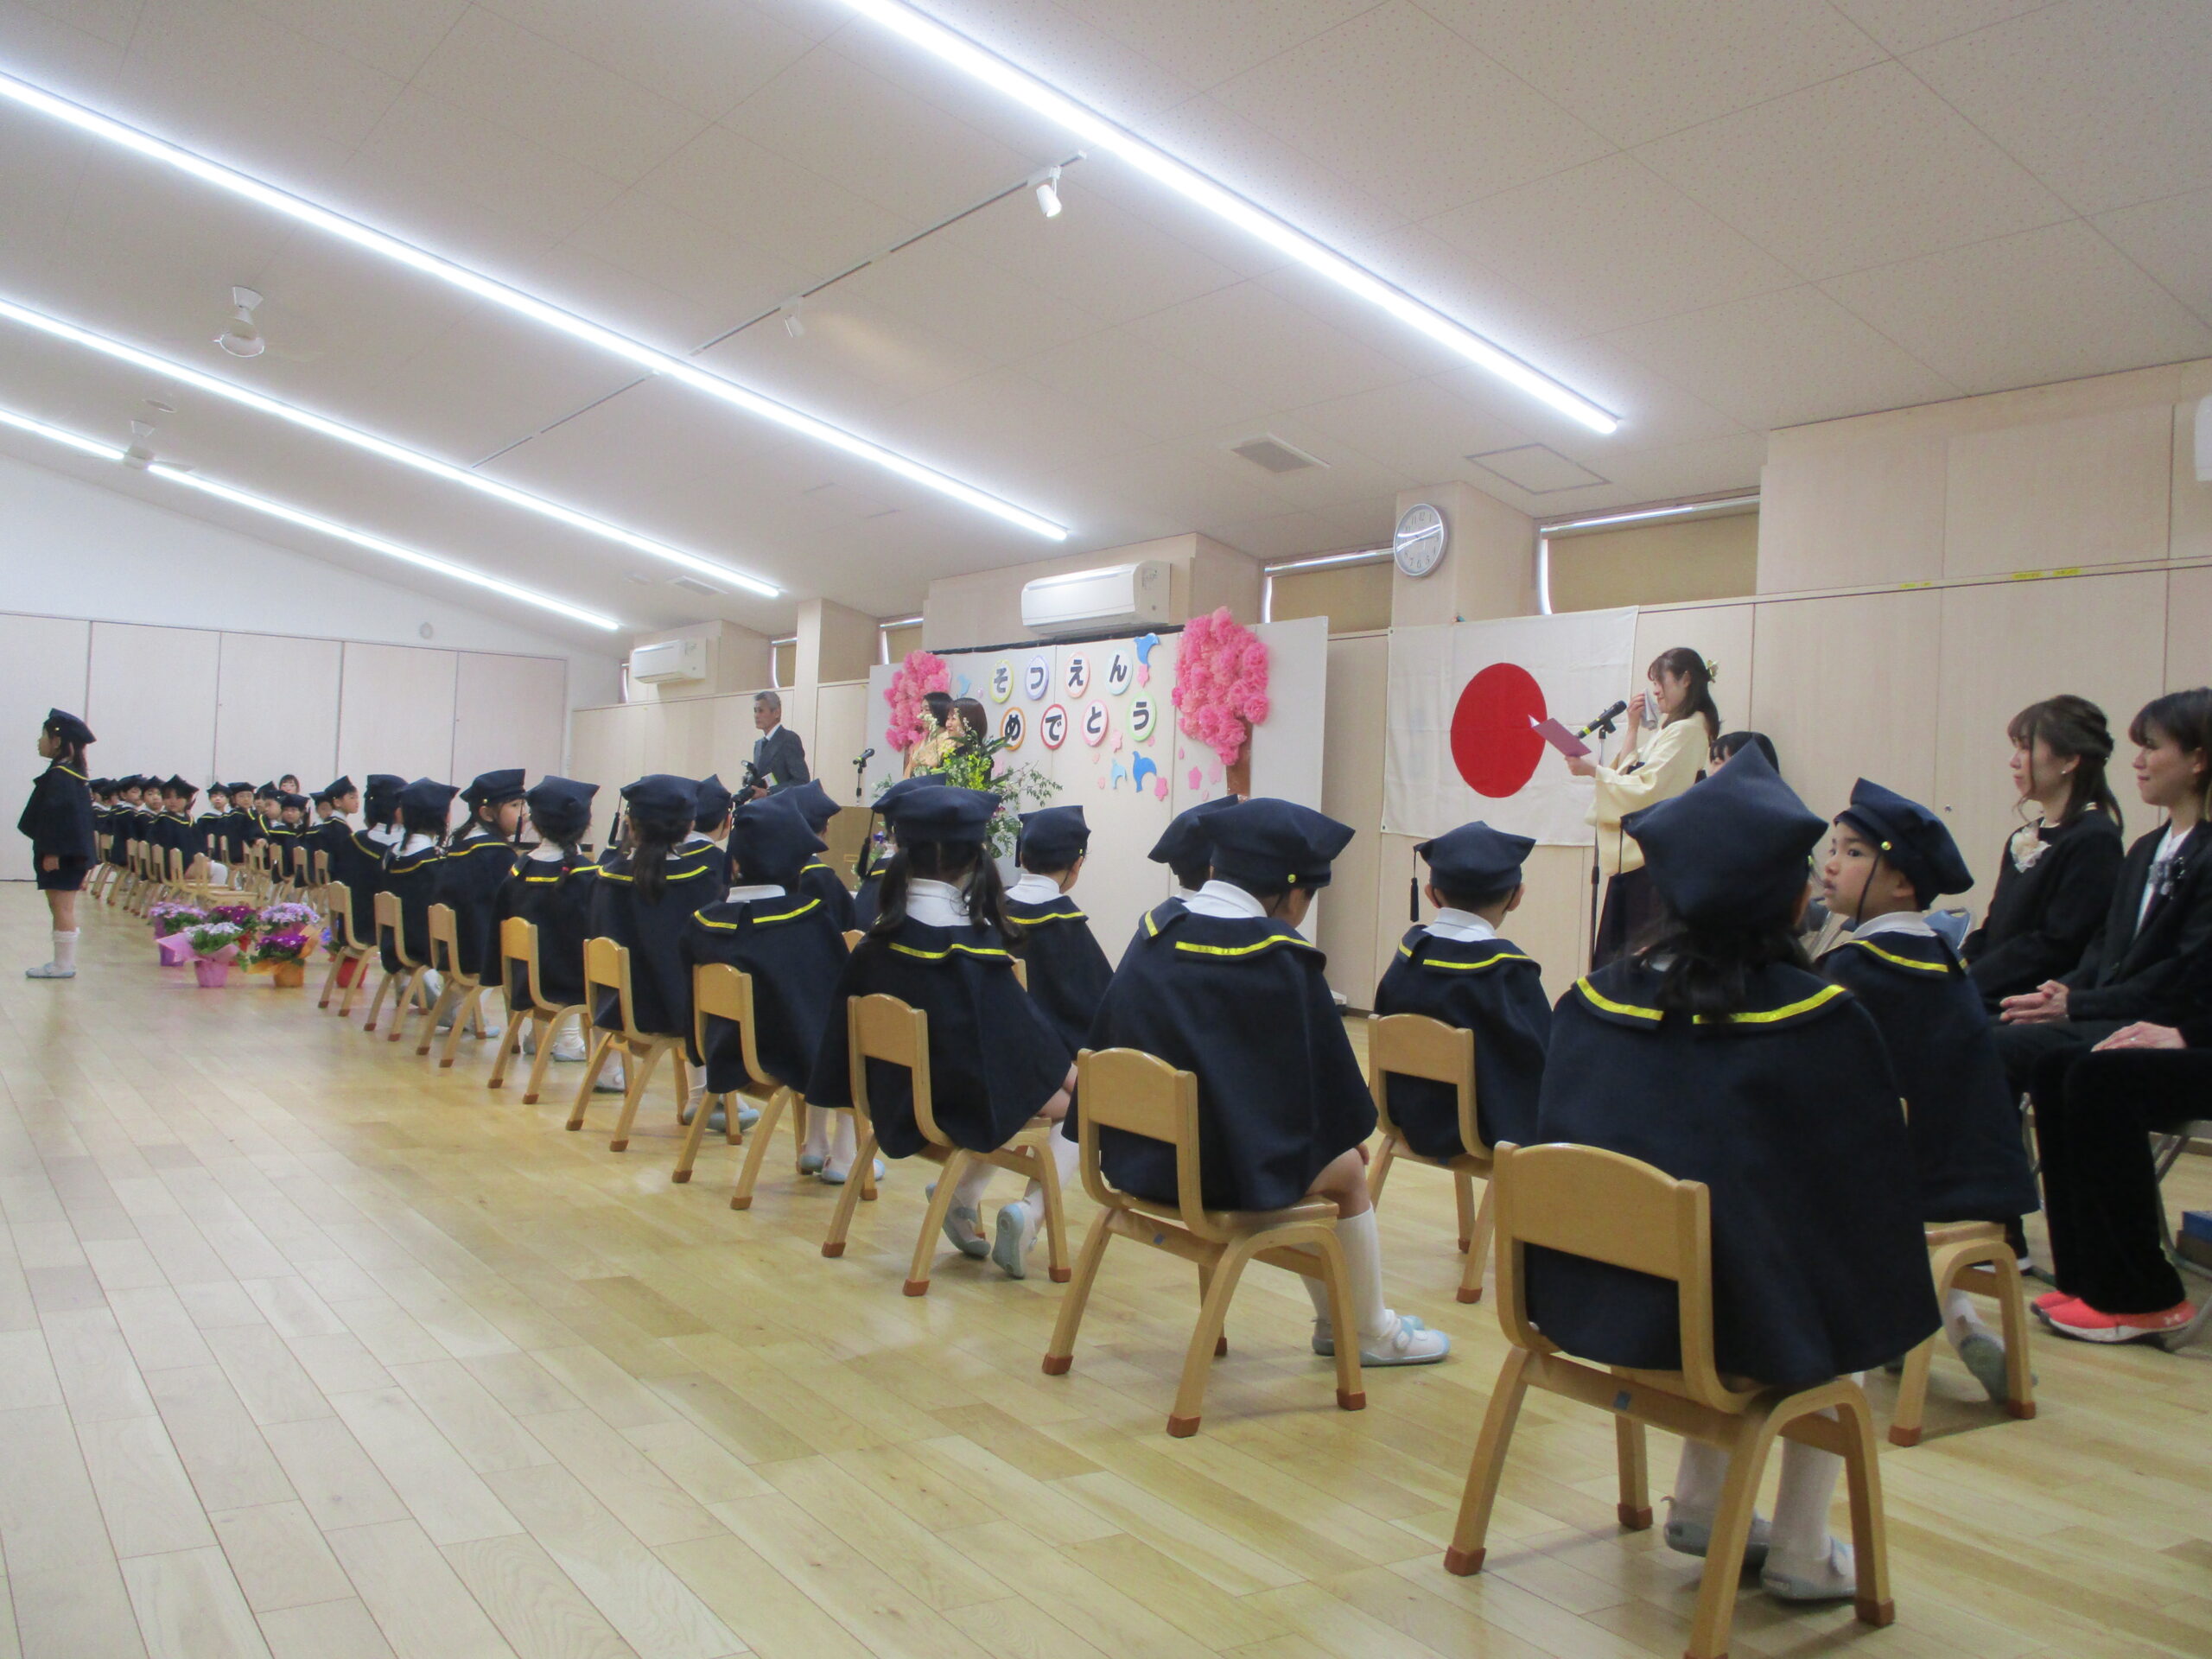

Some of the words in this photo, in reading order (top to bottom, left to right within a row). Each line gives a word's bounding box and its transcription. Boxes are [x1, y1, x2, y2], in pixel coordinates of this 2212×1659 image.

[994, 654, 1128, 693] そつえん
[1004, 702, 1150, 741] めでとう
